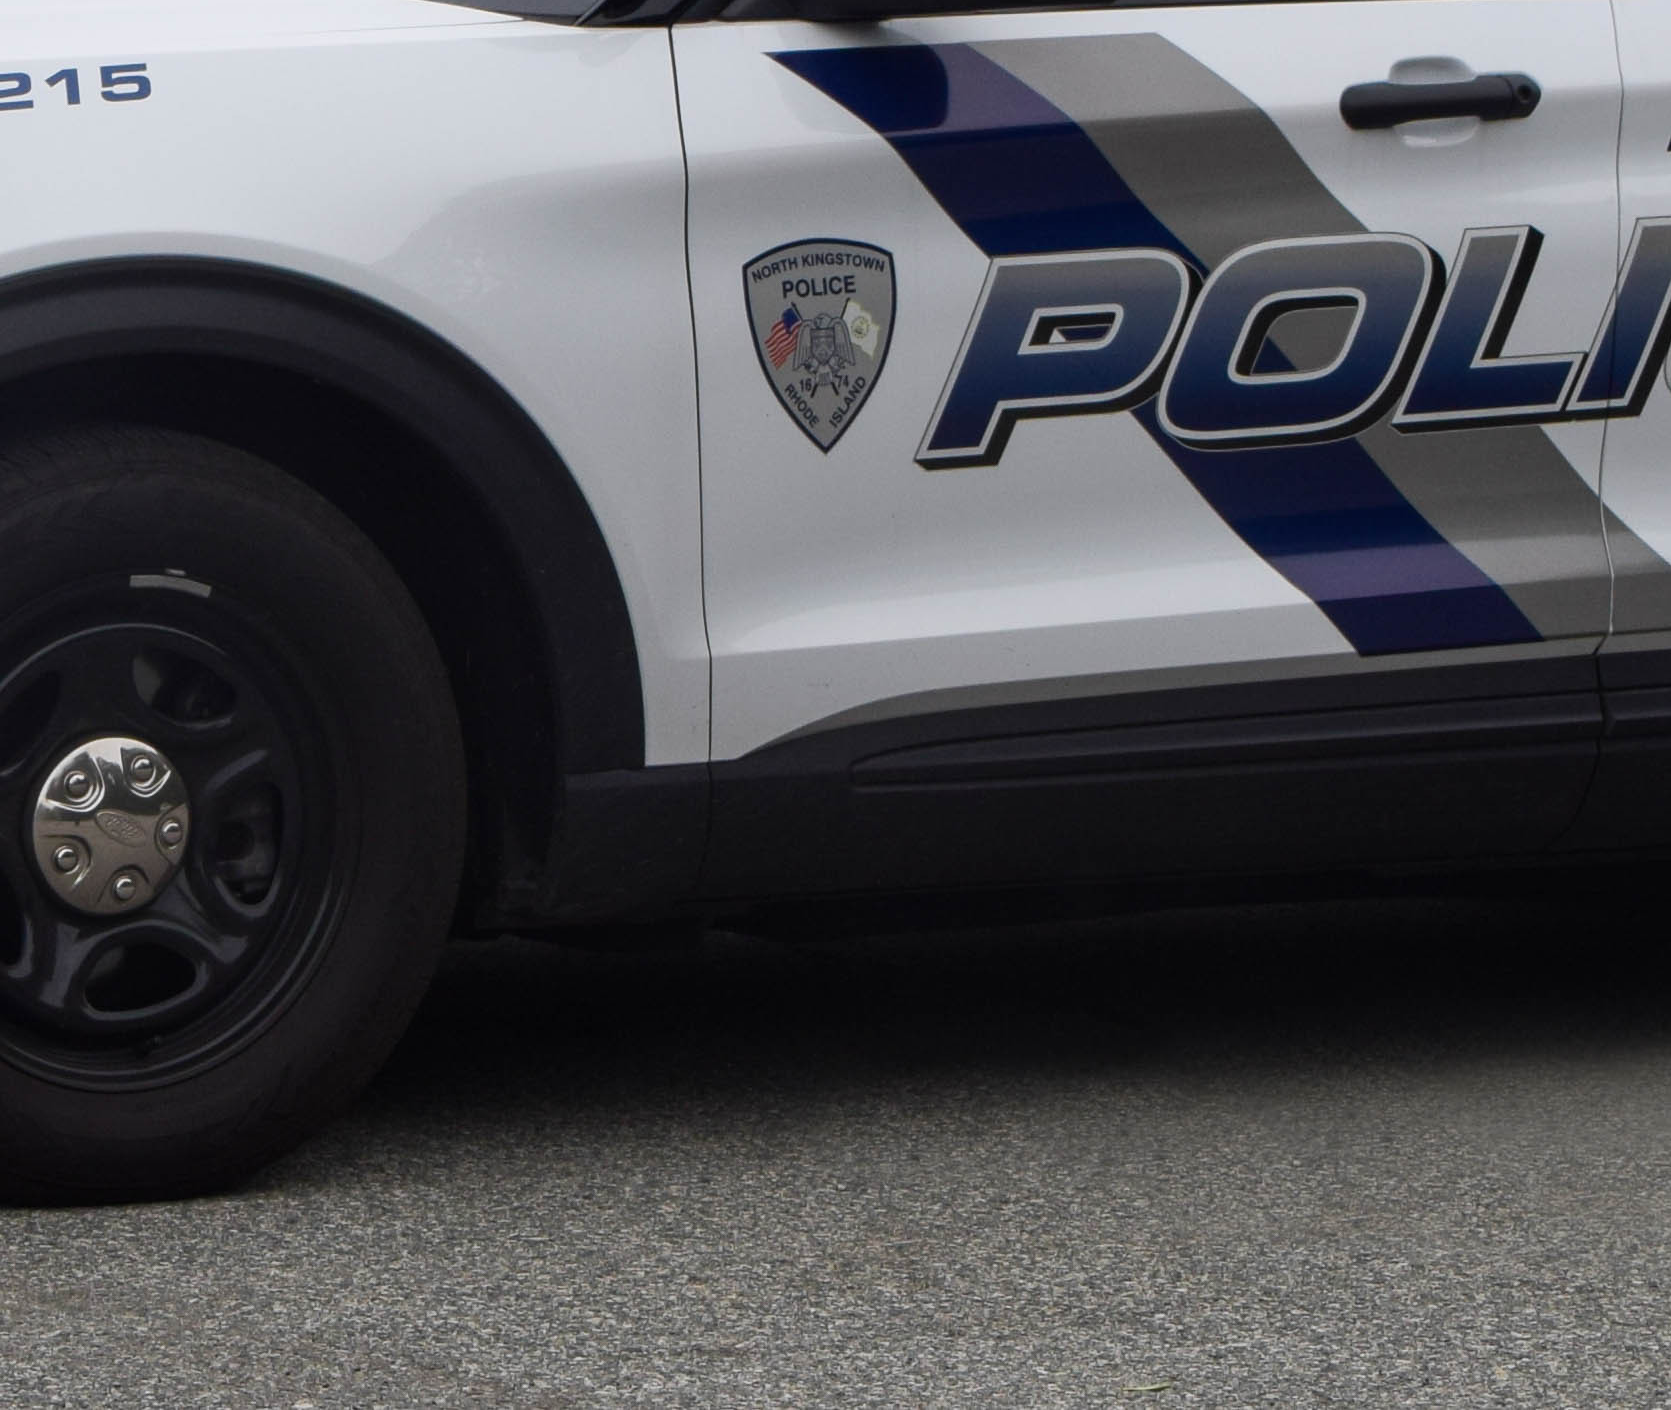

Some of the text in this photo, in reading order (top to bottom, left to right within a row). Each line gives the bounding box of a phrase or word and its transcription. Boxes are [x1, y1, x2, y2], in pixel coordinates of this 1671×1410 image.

[751, 251, 886, 284] NORTH KINGSTOWN
[781, 274, 857, 300] POLICE
[799, 373, 850, 393] 16 74
[784, 382, 820, 429] RHODE
[828, 375, 867, 429] ISLAND
